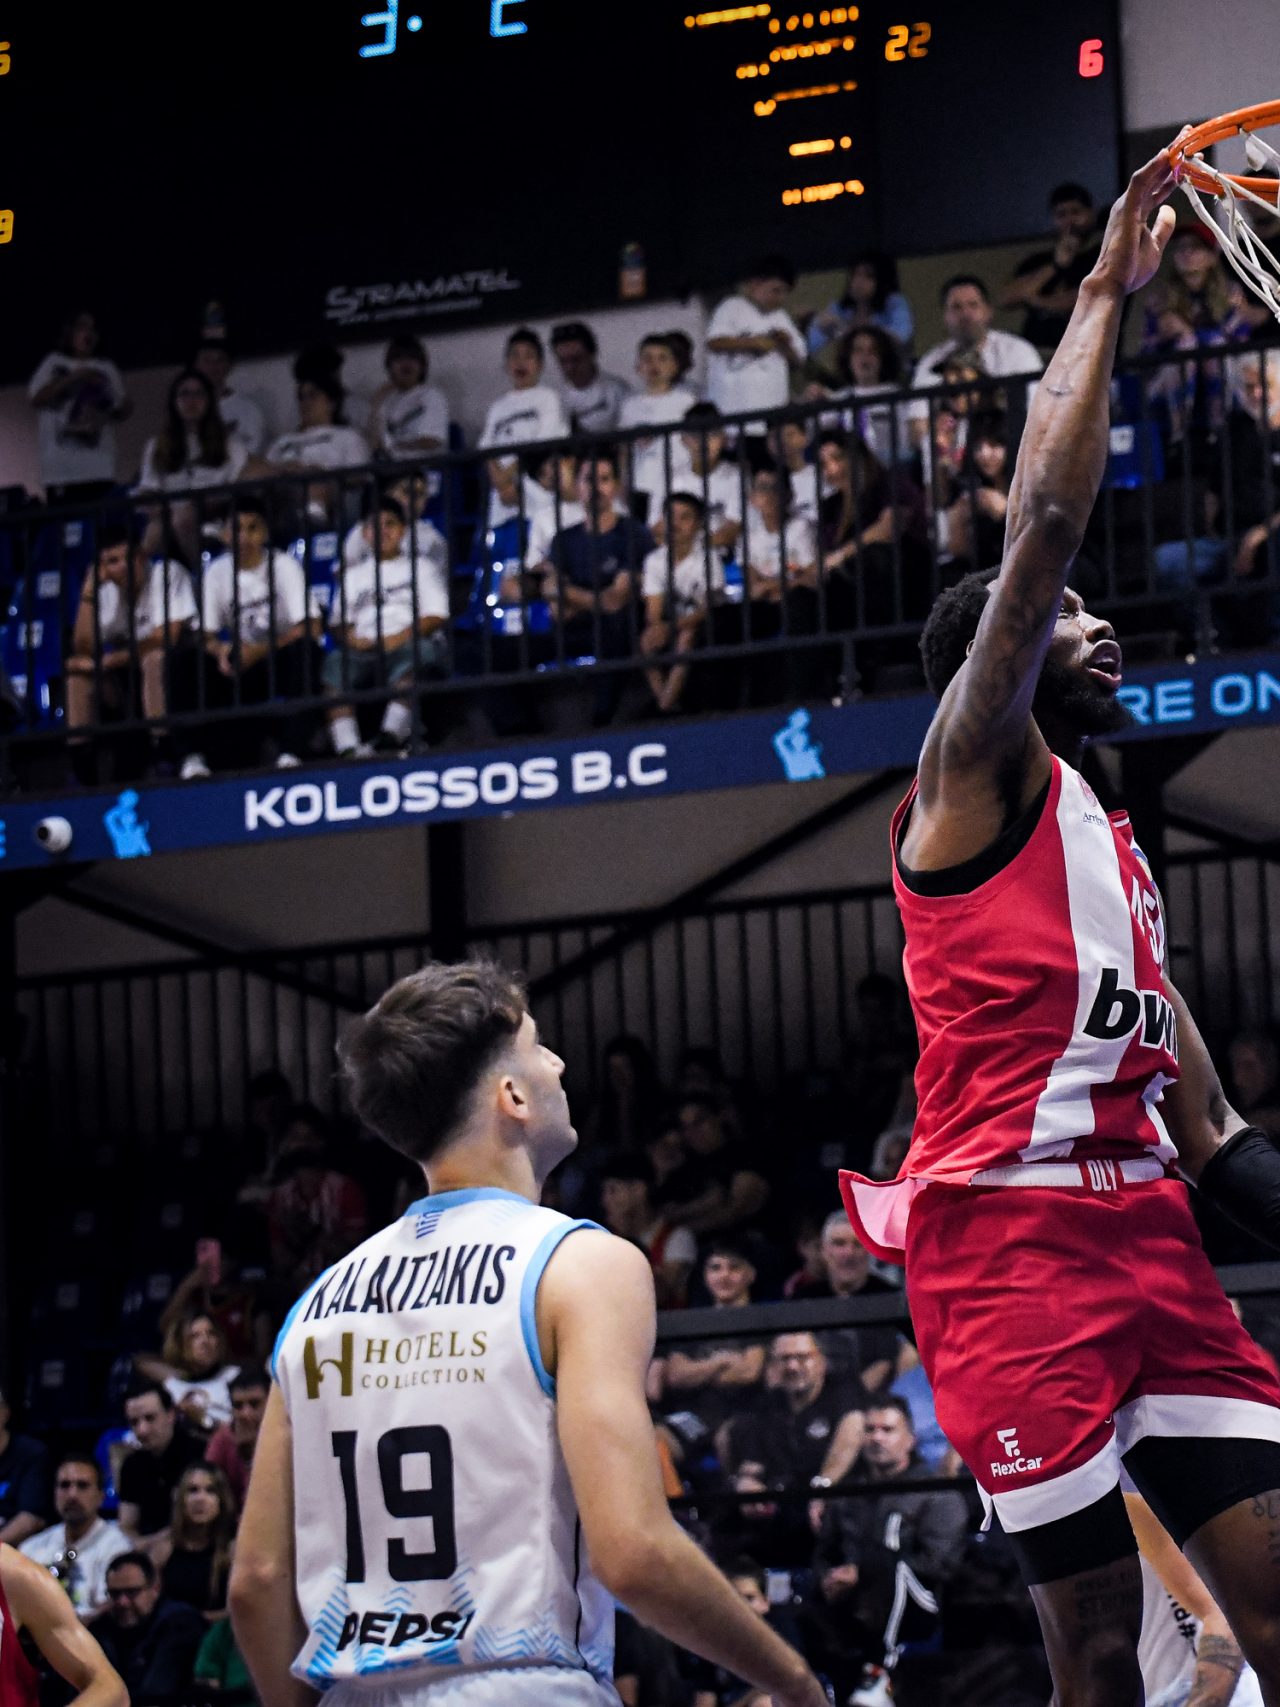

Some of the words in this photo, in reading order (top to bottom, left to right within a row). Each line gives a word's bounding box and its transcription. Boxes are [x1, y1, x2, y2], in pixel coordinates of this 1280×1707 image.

[884, 22, 931, 61] 22
[1078, 38, 1104, 77] 6
[325, 268, 522, 321] STRAMATEL
[1116, 680, 1195, 726] RE
[245, 757, 559, 831] KOLOSSOS
[572, 743, 668, 794] B.C
[303, 1244, 516, 1323] KALAITZAKIS
[363, 1330, 488, 1364] HOTELS
[361, 1368, 486, 1389] COLLECTION
[990, 1456, 1043, 1478] FlexCar
[331, 1424, 458, 1583] 19
[336, 1609, 477, 1651] PEPSI
